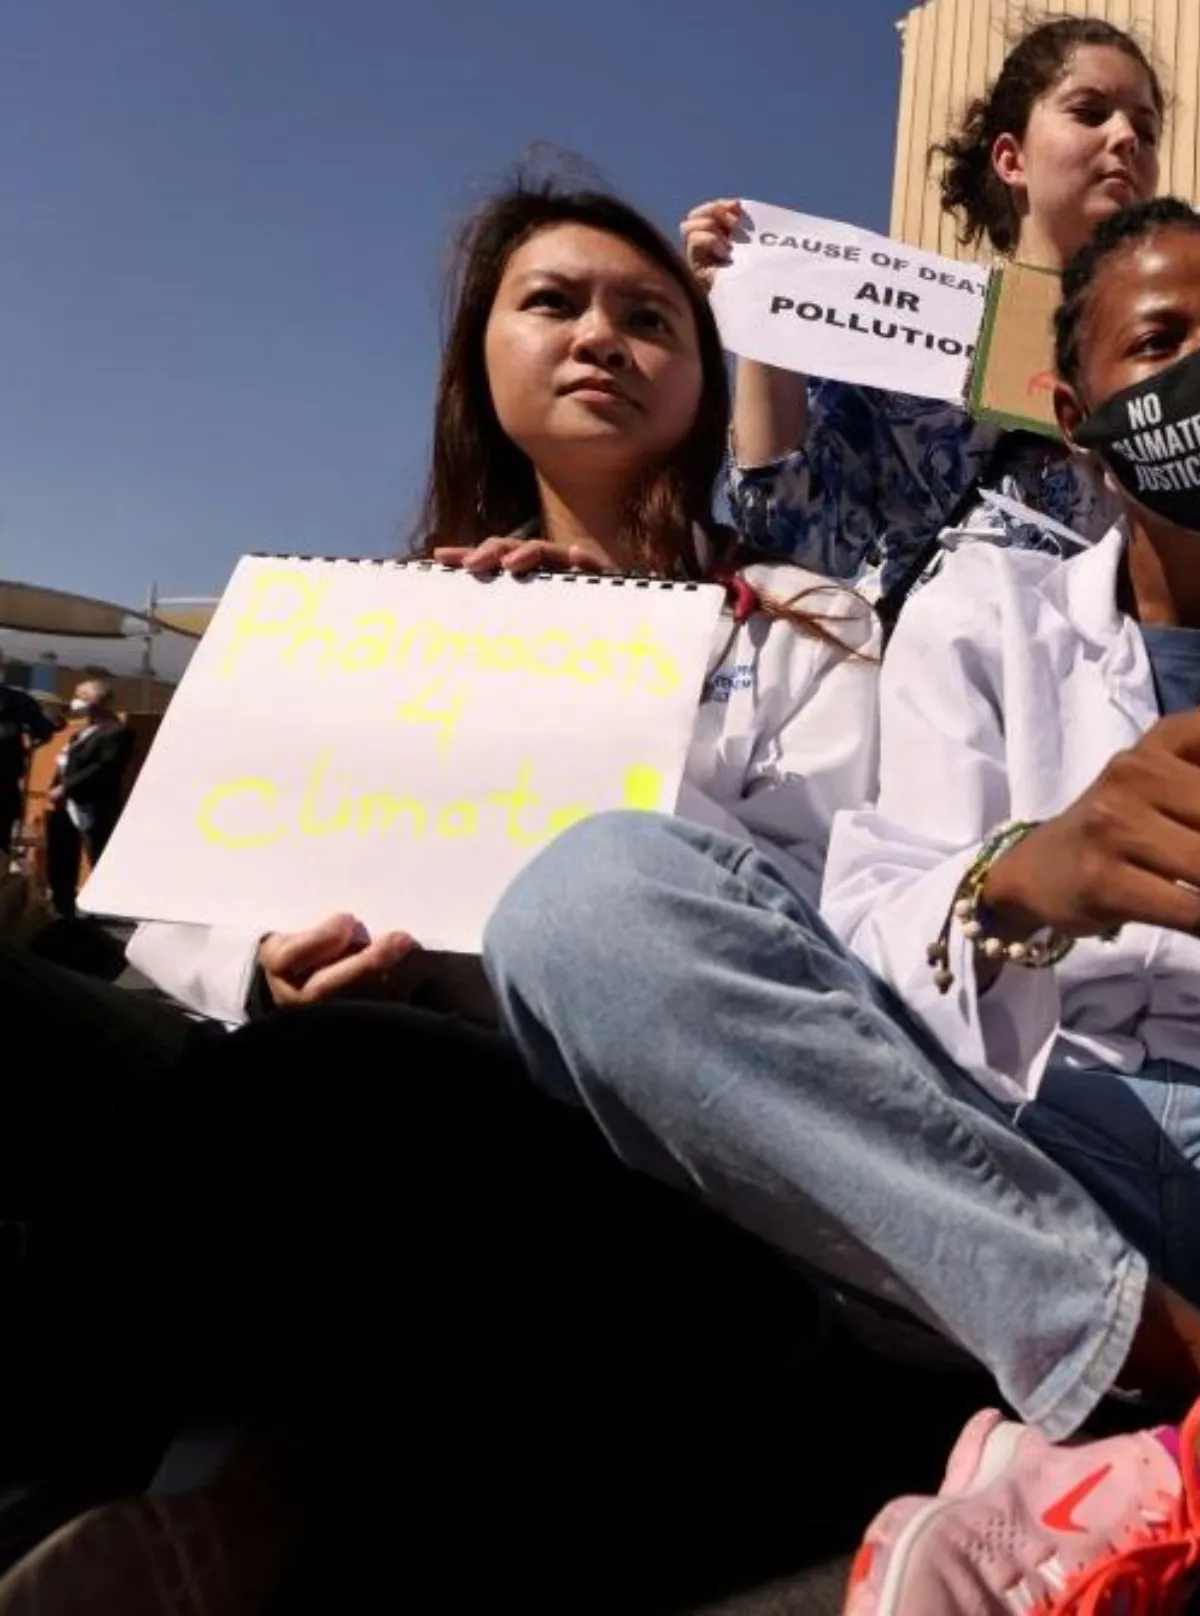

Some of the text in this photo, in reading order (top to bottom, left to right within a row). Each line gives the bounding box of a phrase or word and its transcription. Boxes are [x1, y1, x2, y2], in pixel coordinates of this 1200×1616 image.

[759, 232, 862, 262] CAUSE
[870, 251, 910, 272] OF
[854, 281, 921, 313] AIR
[1127, 392, 1162, 431] NO
[396, 676, 467, 764] 4
